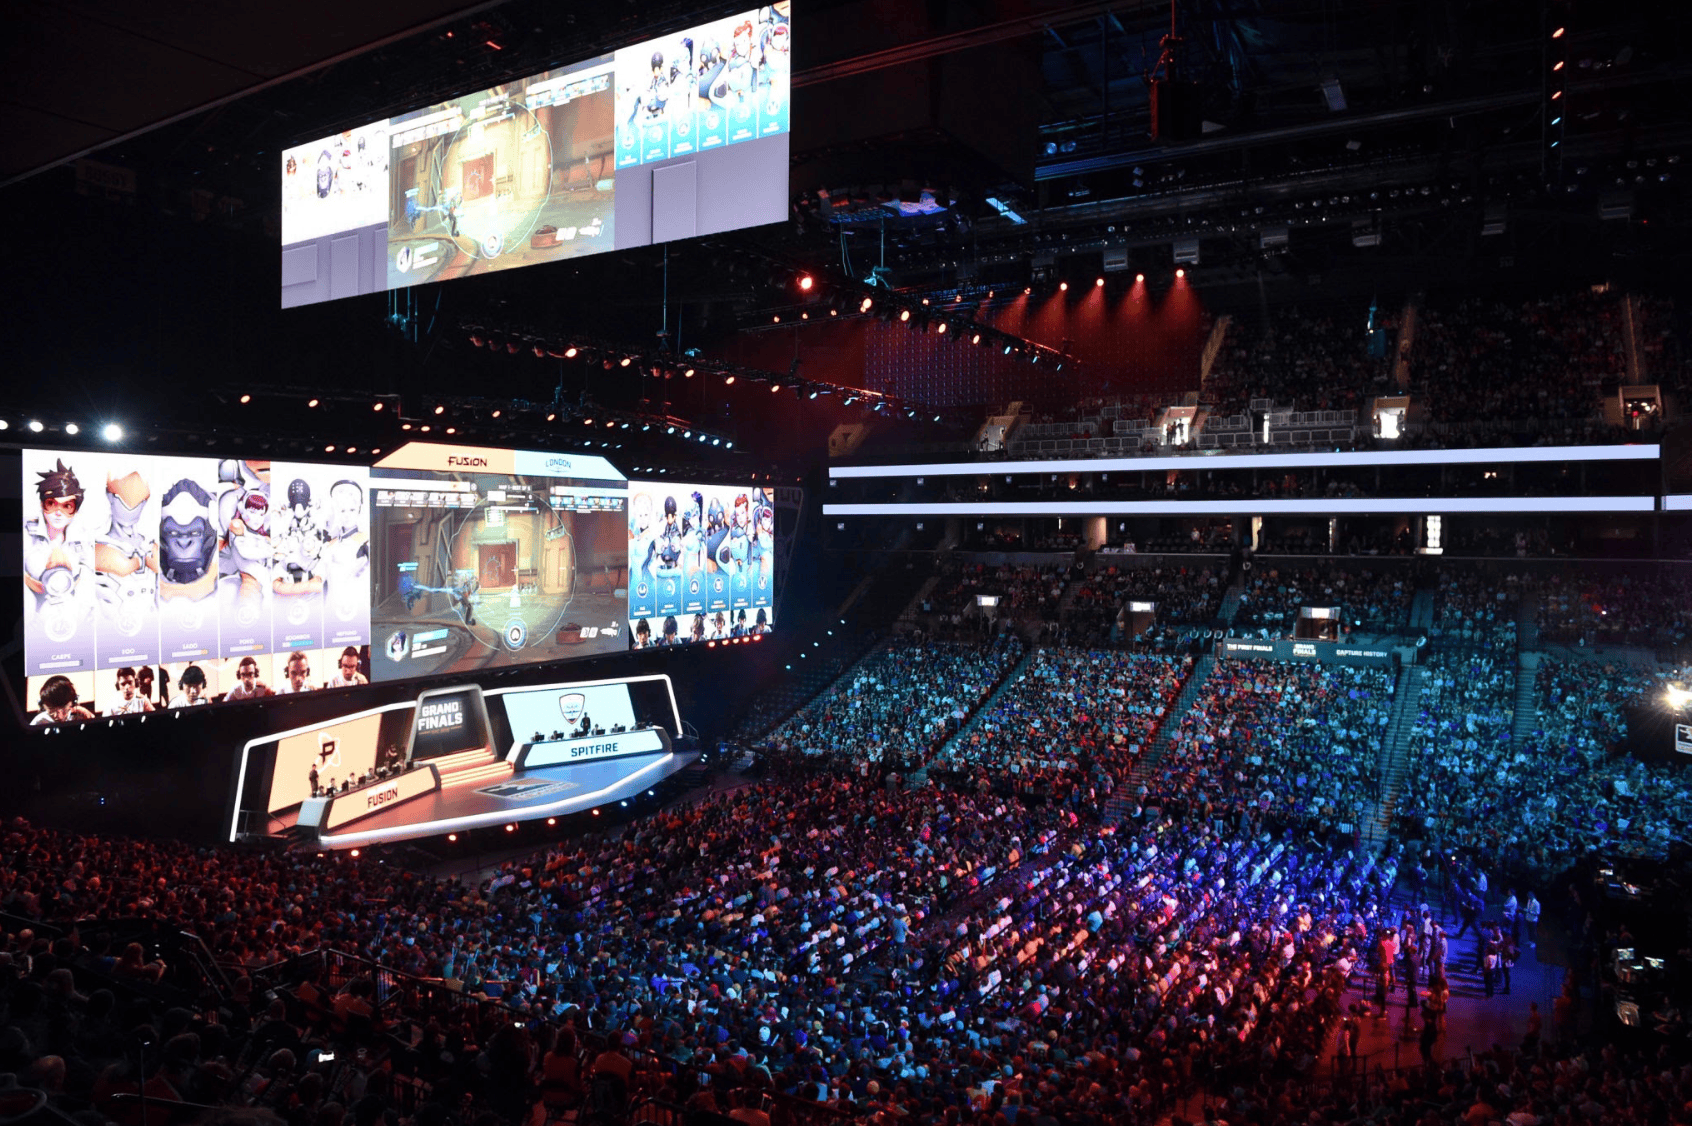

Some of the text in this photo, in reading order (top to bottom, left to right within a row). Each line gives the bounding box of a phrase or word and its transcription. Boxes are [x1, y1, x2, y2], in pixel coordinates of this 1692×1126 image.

[447, 456, 488, 467] FUSION
[545, 458, 572, 469] LONDON
[422, 701, 459, 717] GRAND
[418, 712, 463, 731] FINALS
[570, 742, 619, 757] SPITFIRE
[367, 787, 398, 808] FUSION
